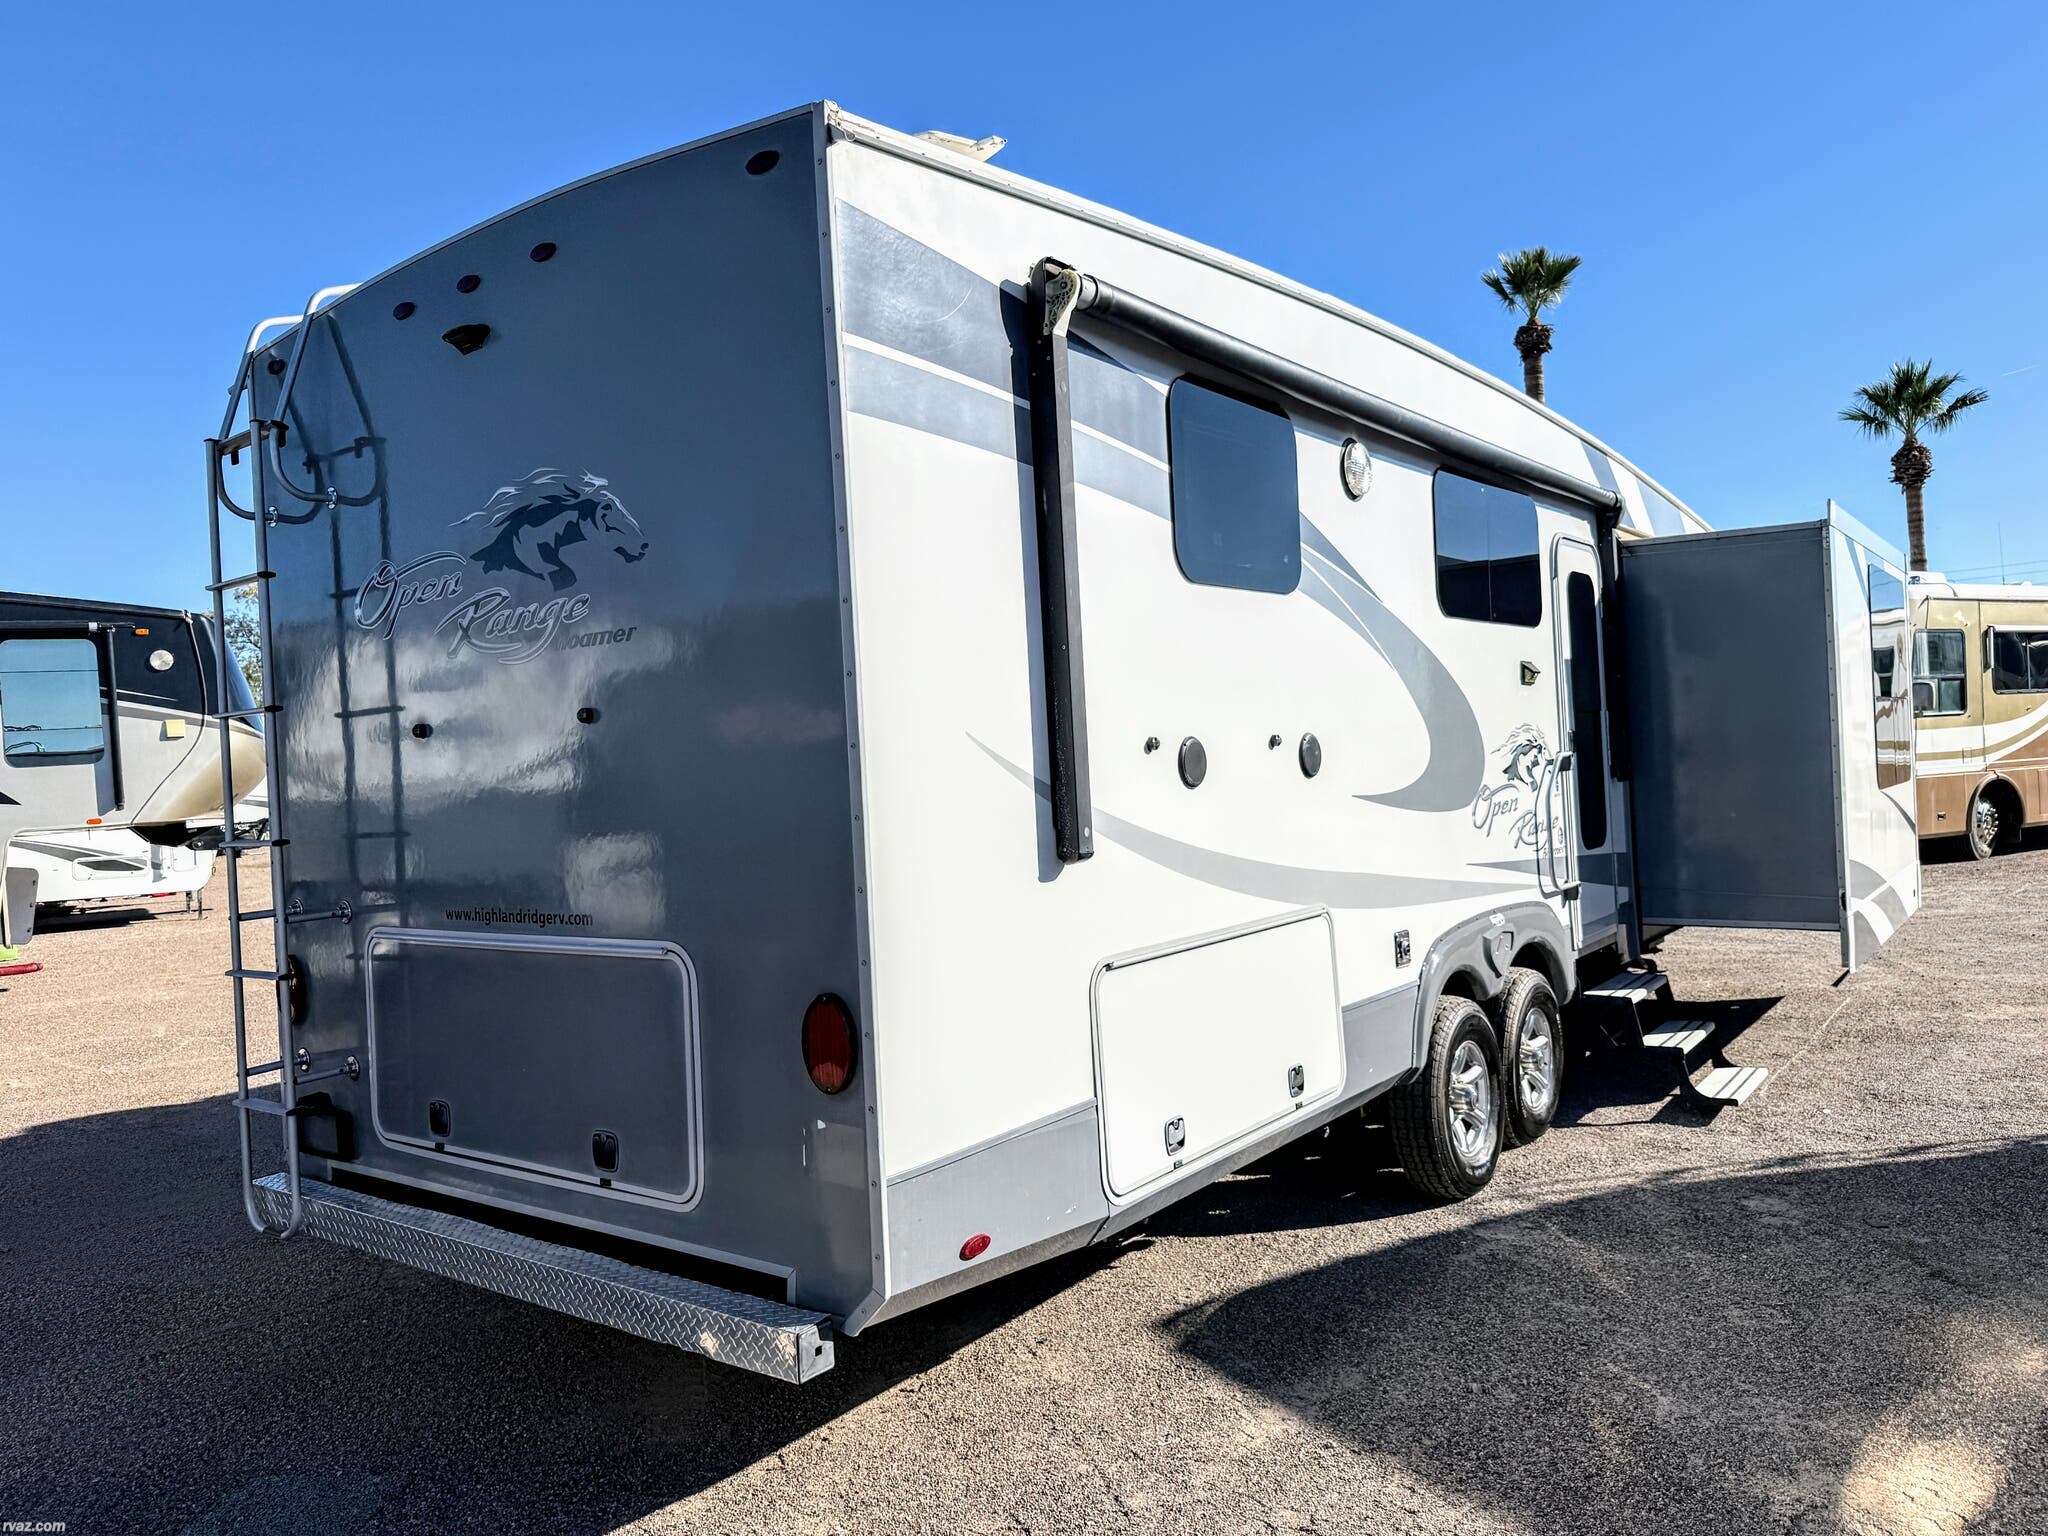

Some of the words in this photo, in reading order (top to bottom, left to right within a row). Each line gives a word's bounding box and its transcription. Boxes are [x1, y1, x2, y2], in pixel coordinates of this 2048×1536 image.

[355, 550, 467, 640] Open
[433, 587, 591, 665] Range
[1473, 784, 1519, 837] Open
[445, 907, 593, 928] www.highlandridgerv.com
